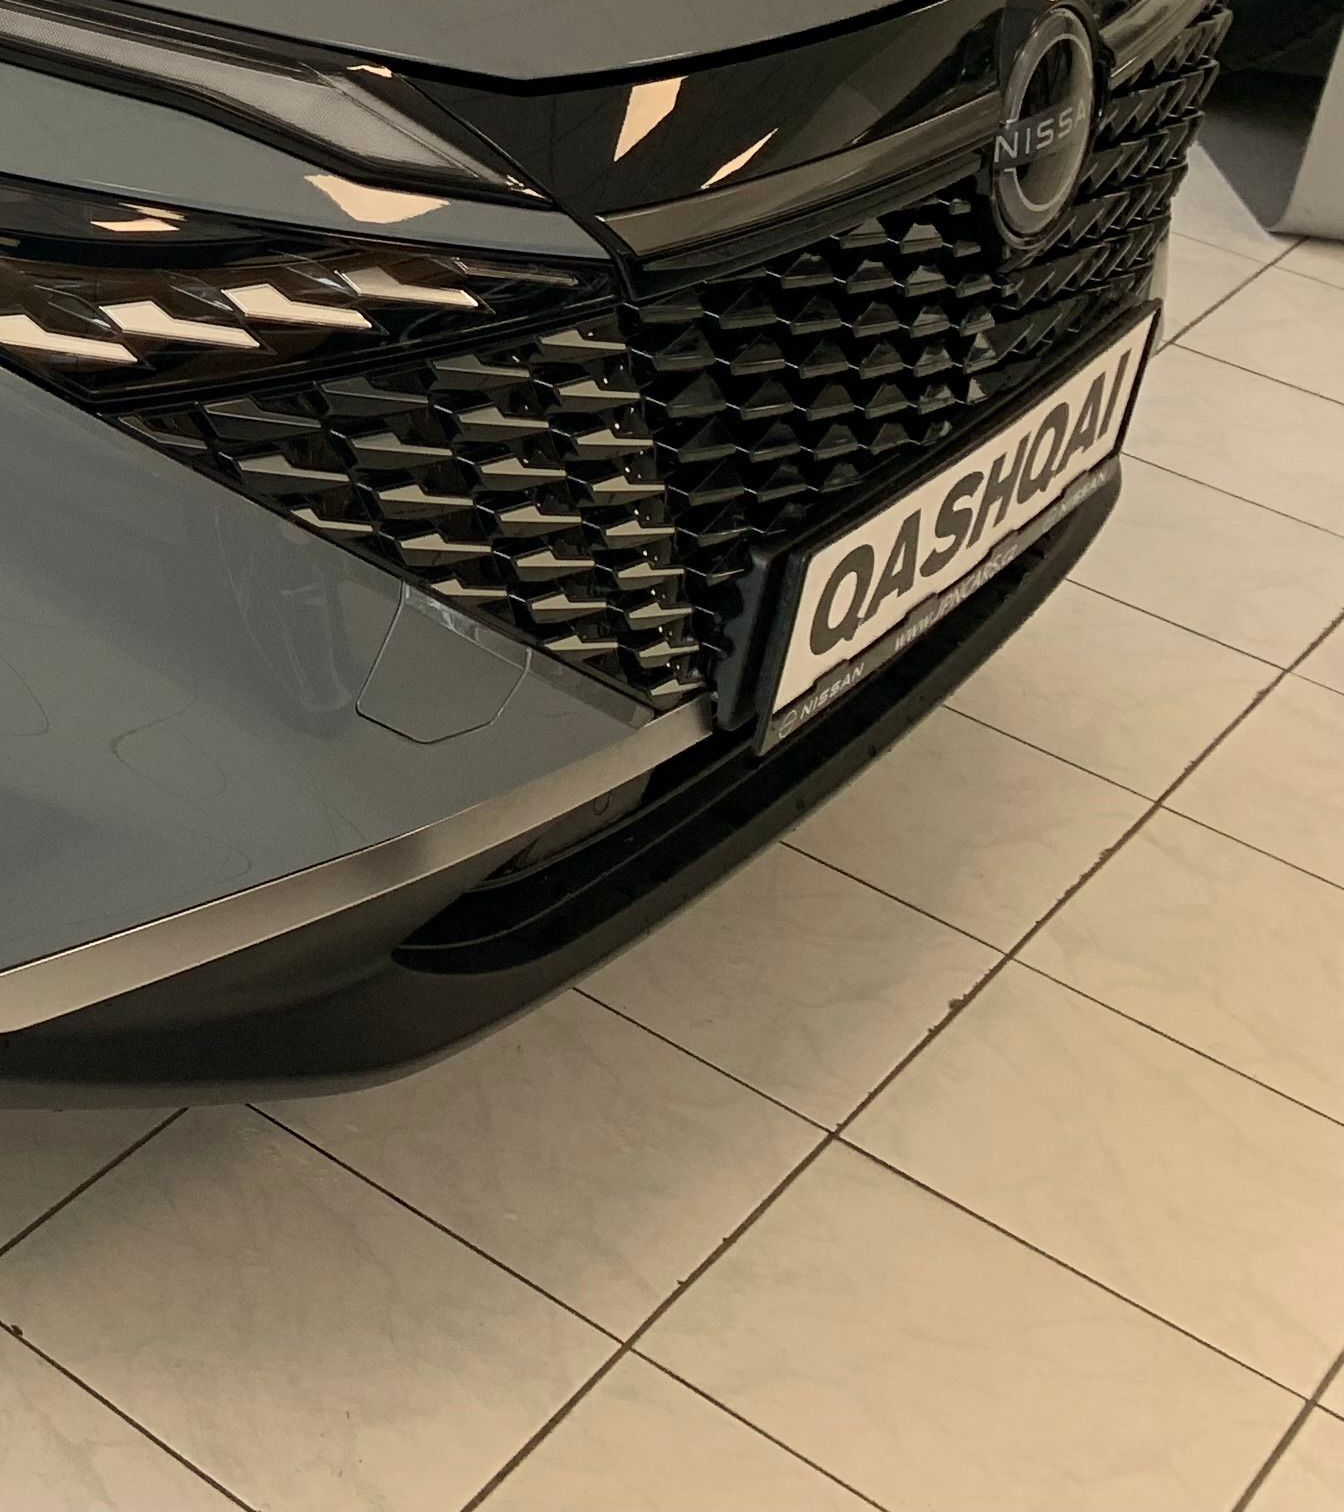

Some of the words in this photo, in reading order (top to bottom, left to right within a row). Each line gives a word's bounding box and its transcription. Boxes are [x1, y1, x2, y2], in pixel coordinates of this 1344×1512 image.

[994, 98, 1088, 163] NISSA
[809, 347, 1133, 656] QASHQAI
[799, 662, 865, 720] NISSAN
